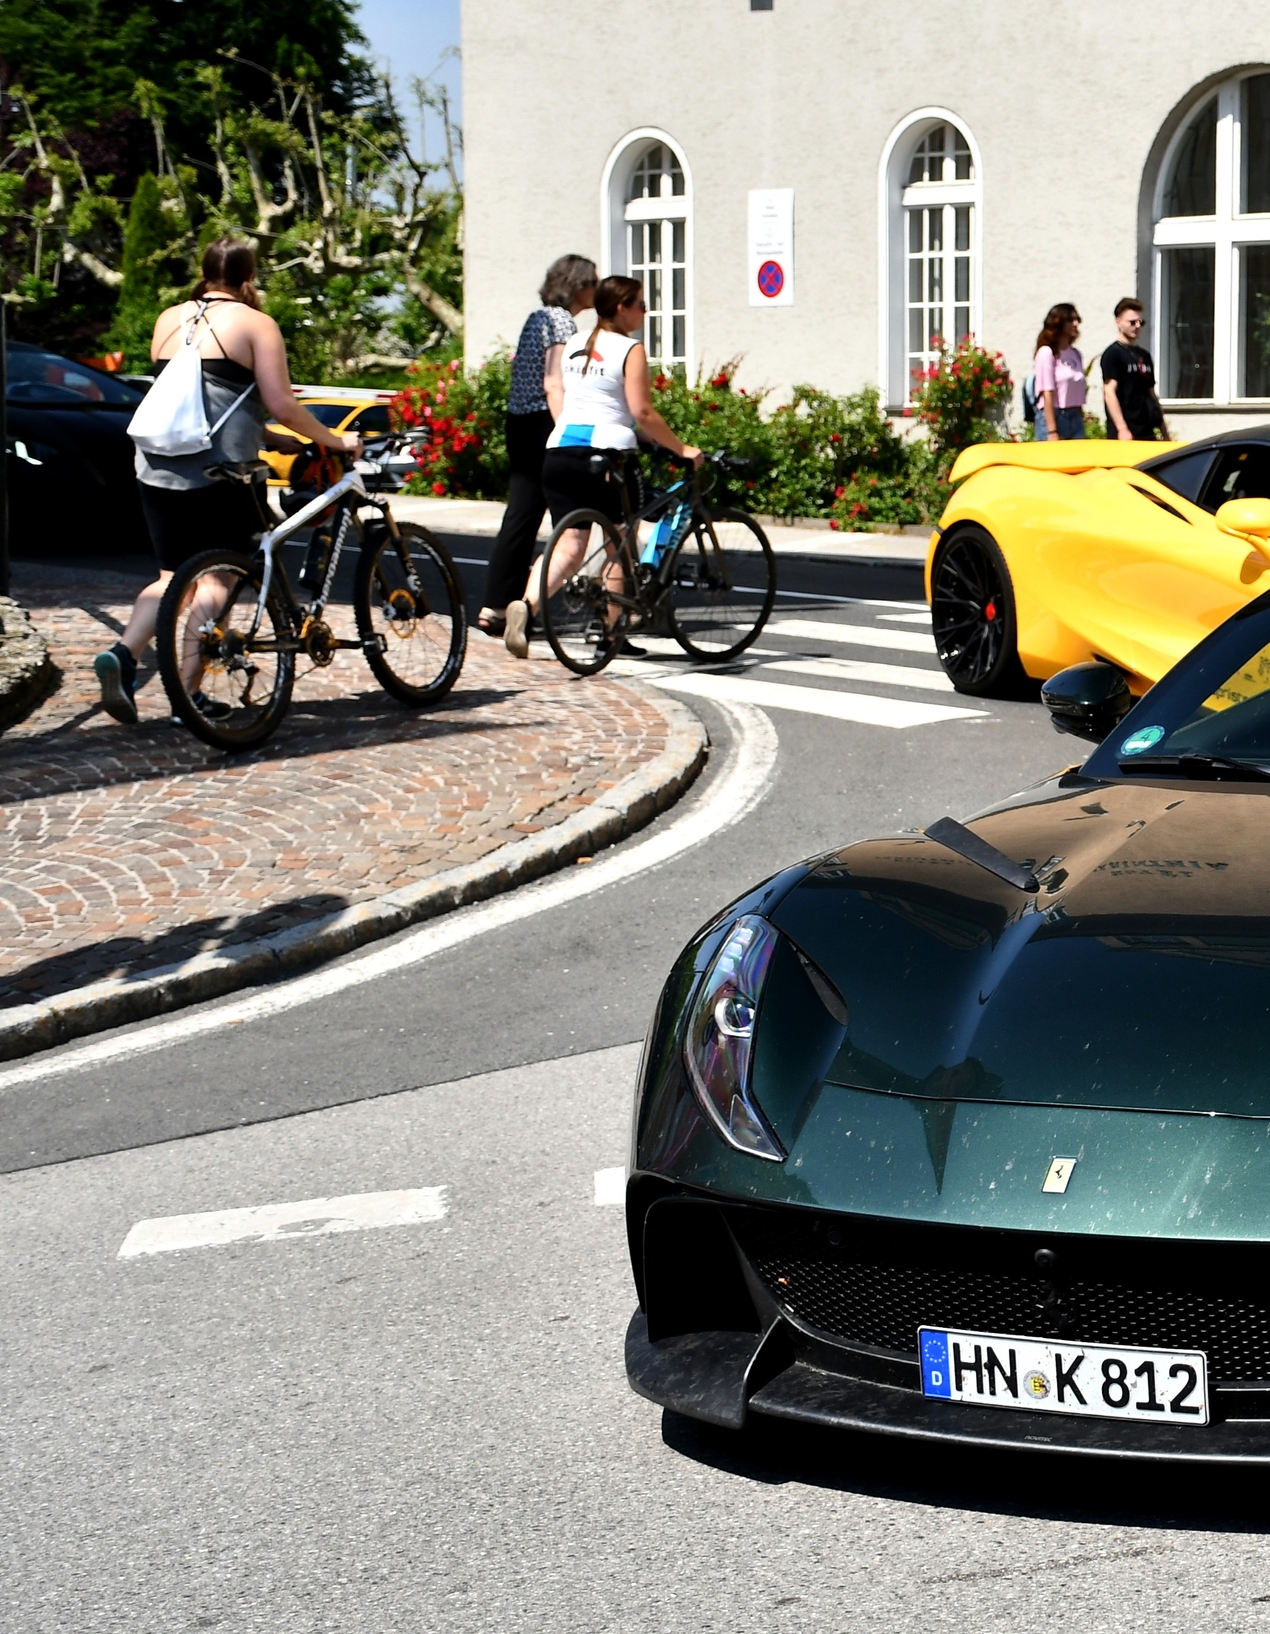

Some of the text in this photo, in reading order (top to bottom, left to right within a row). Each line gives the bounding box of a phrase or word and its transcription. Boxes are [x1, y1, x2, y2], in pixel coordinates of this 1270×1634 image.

[931, 1371, 943, 1386] D
[952, 1342, 1200, 1415] HN K 812
